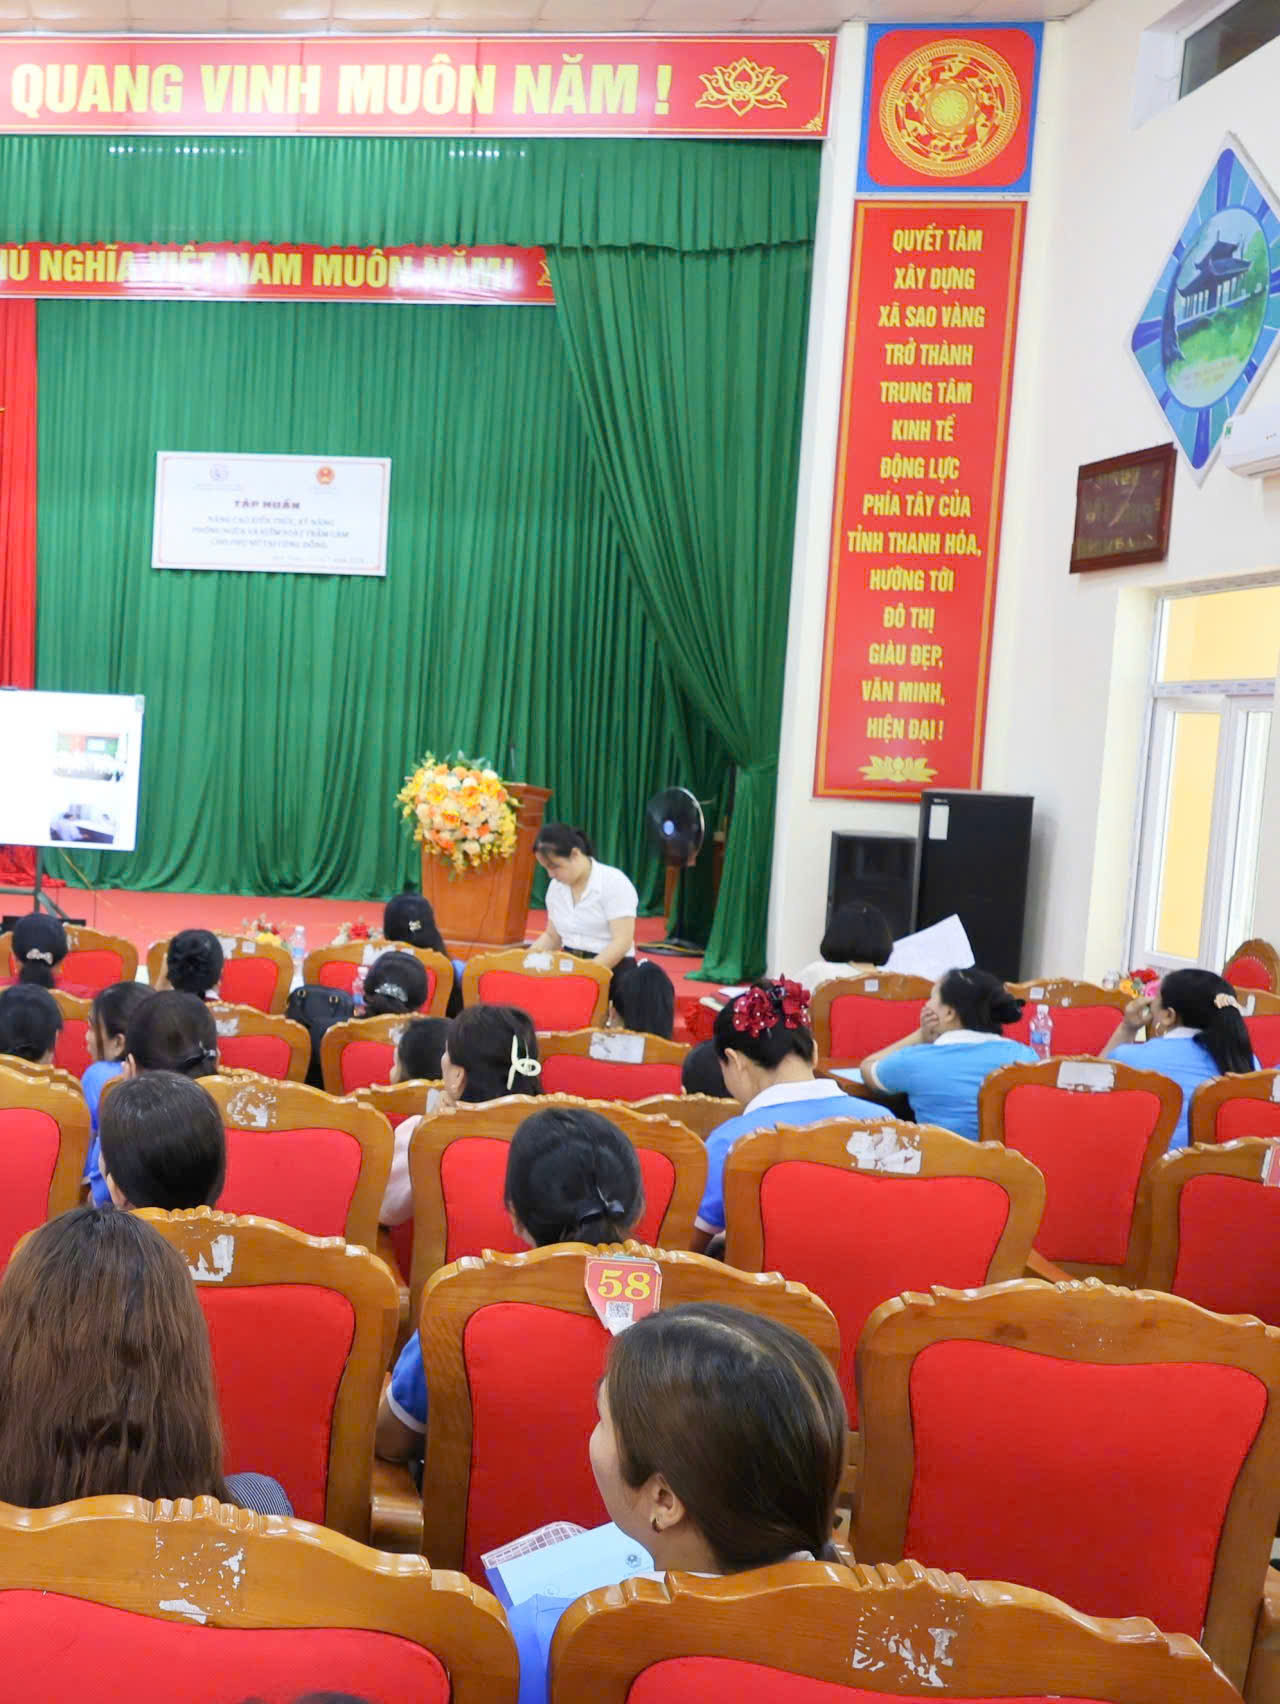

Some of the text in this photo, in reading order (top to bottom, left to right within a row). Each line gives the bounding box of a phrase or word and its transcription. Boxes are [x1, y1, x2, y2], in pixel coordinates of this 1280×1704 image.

[11, 63, 183, 118] QUANG
[200, 65, 321, 114] VINH
[337, 53, 496, 115] MUÔN
[512, 53, 639, 115] NĂM
[654, 65, 672, 115] !
[892, 222, 983, 253] QUYẾT TÂM
[39, 244, 136, 283] NGHĨA
[227, 252, 303, 286] NAM
[313, 248, 413, 288] MUÔN
[894, 263, 976, 295] XÂY DỰNG
[878, 300, 986, 329] XÃ SAO VÀNG
[885, 337, 974, 366] TRỞ THÀNH
[880, 377, 973, 405] TRUNG TÂM
[891, 412, 957, 442] KINH TẾ
[880, 452, 961, 485] ĐỘNG LỰC
[862, 488, 972, 518] PHÍA TÂY CỦA
[847, 523, 884, 553] TỈNH
[888, 531, 941, 555] THANH
[883, 602, 936, 634] ĐÔ THỊ
[868, 639, 907, 666] GIÀU
[861, 676, 895, 702] VĂN
[866, 712, 905, 744] HIỆN
[597, 1269, 651, 1300] 58
